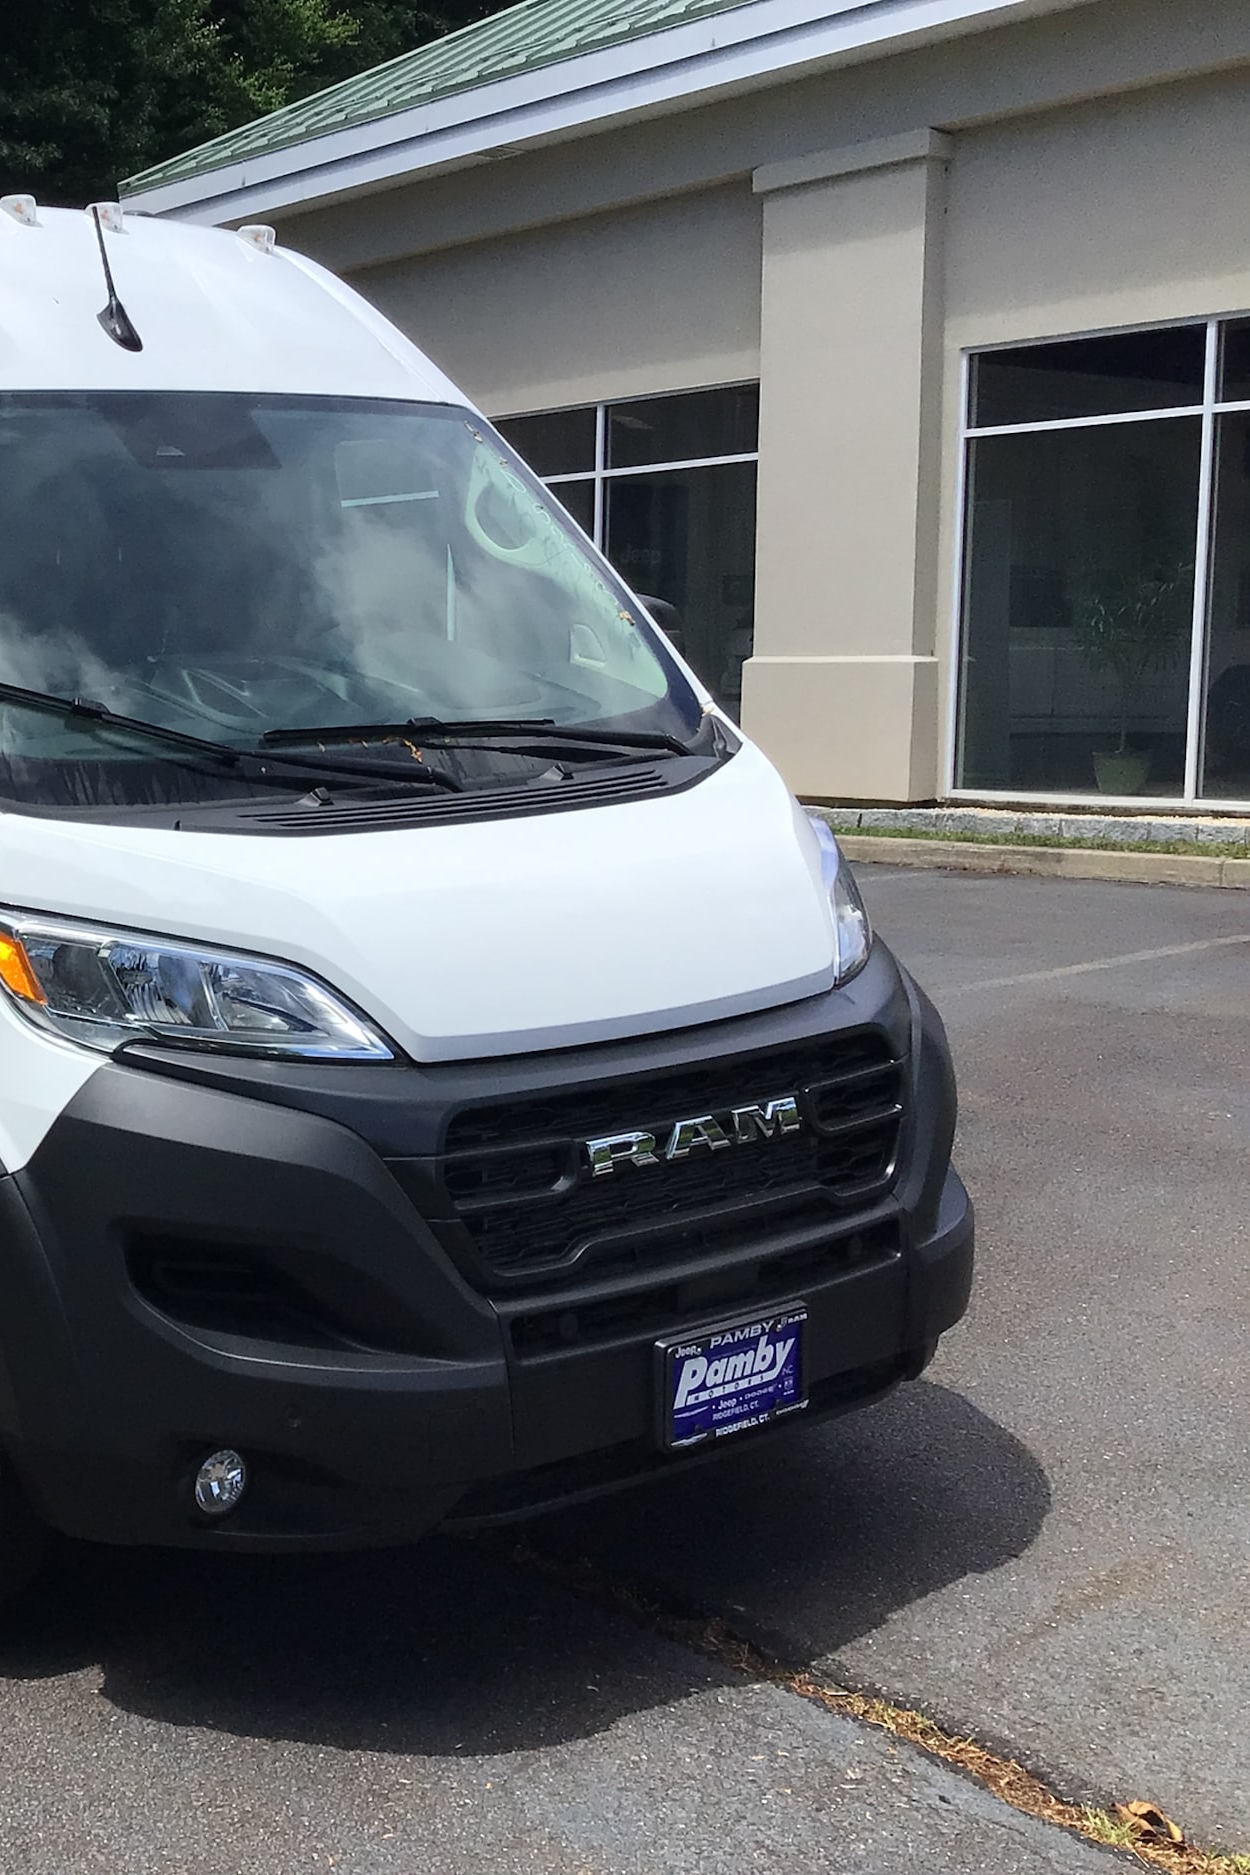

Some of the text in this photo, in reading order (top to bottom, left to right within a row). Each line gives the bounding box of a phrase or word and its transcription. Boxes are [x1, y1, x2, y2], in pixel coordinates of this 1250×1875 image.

[586, 1097, 800, 1176] RAM
[710, 1320, 774, 1349] PAMBY
[673, 1335, 796, 1409] Pamby
[718, 1398, 736, 1409] Jeep
